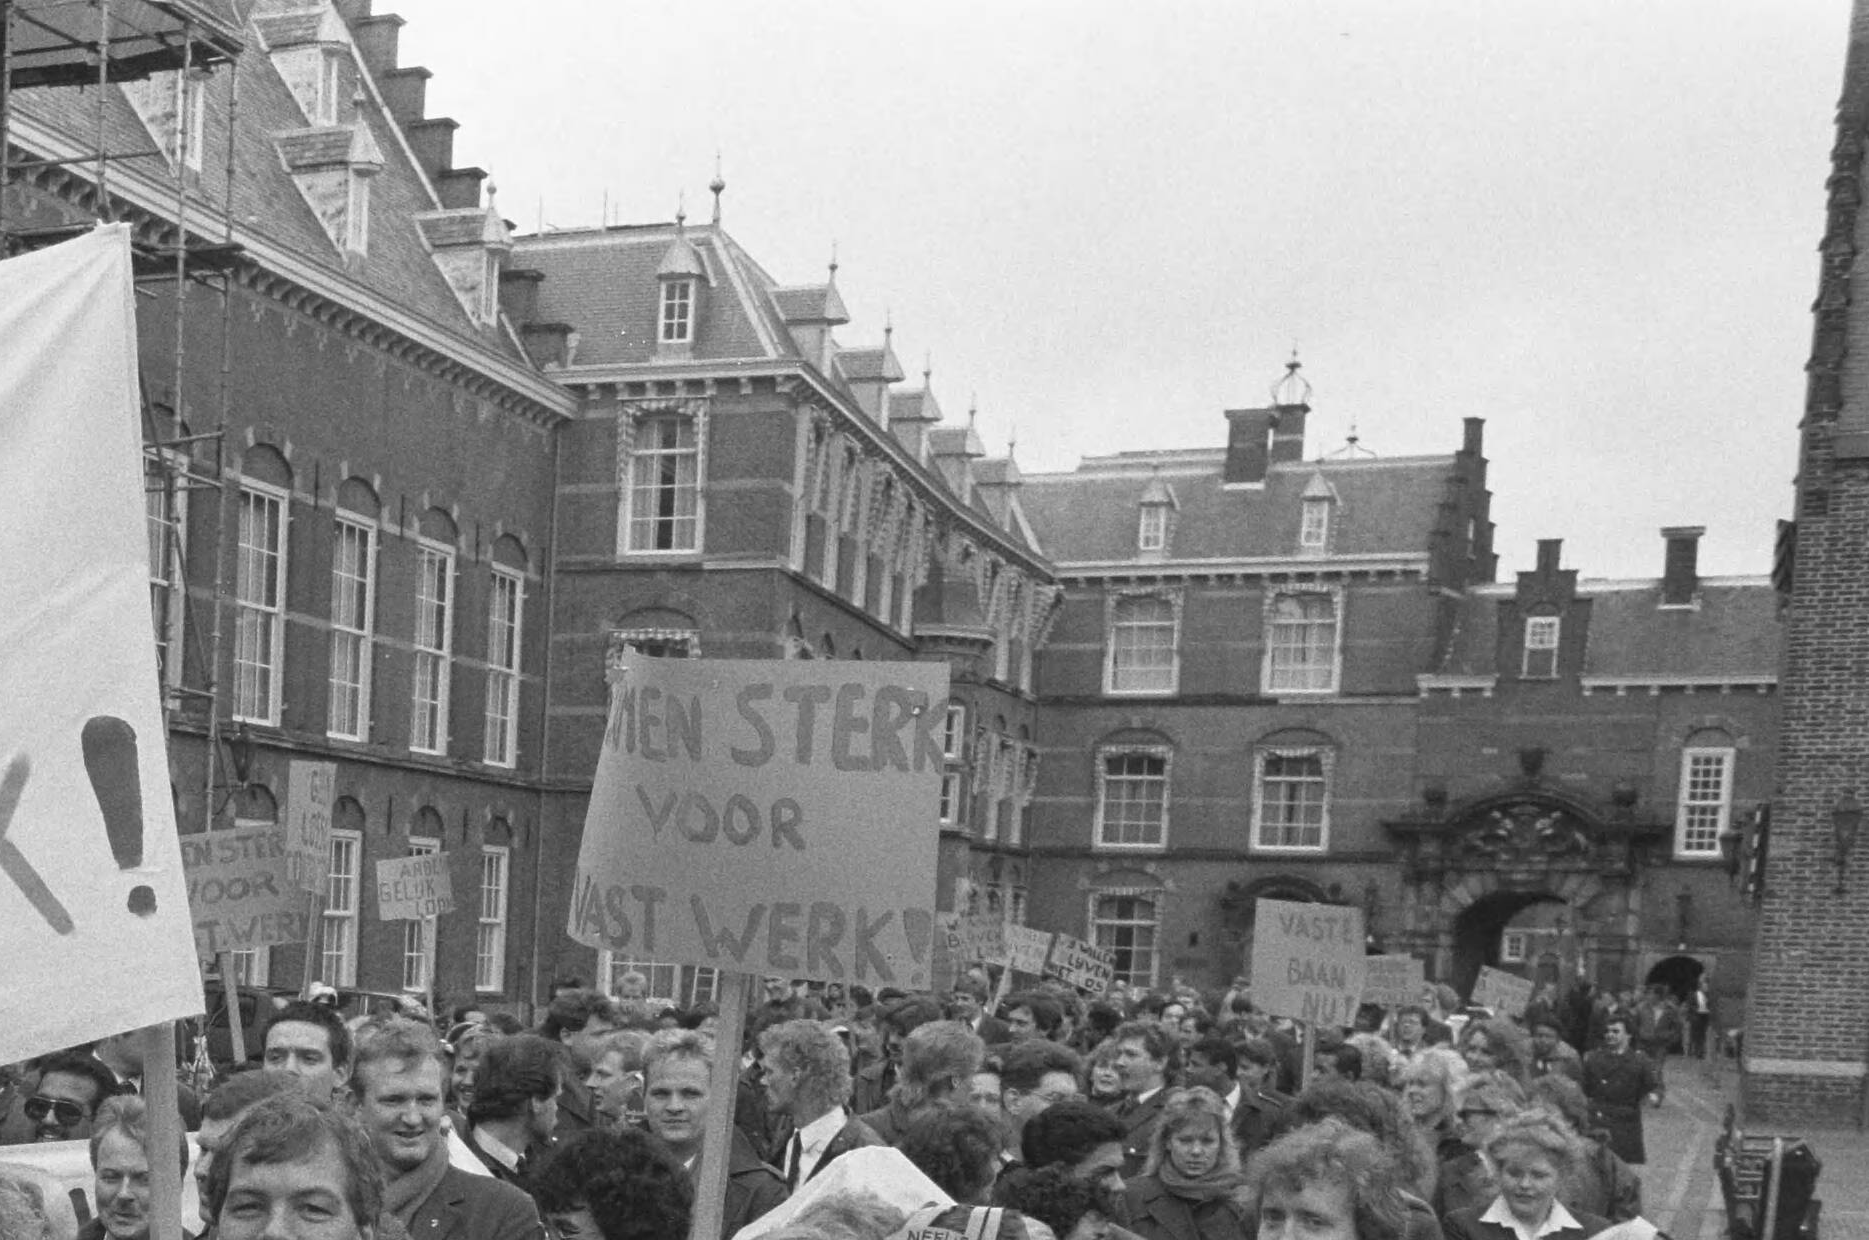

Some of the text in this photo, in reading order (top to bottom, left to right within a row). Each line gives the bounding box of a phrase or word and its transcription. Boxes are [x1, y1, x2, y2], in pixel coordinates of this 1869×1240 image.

[731, 682, 948, 775] STERK
[217, 830, 285, 864] STER
[634, 782, 806, 851] VOOR
[689, 894, 932, 986] WERK!
[1286, 955, 1348, 991] BAAN
